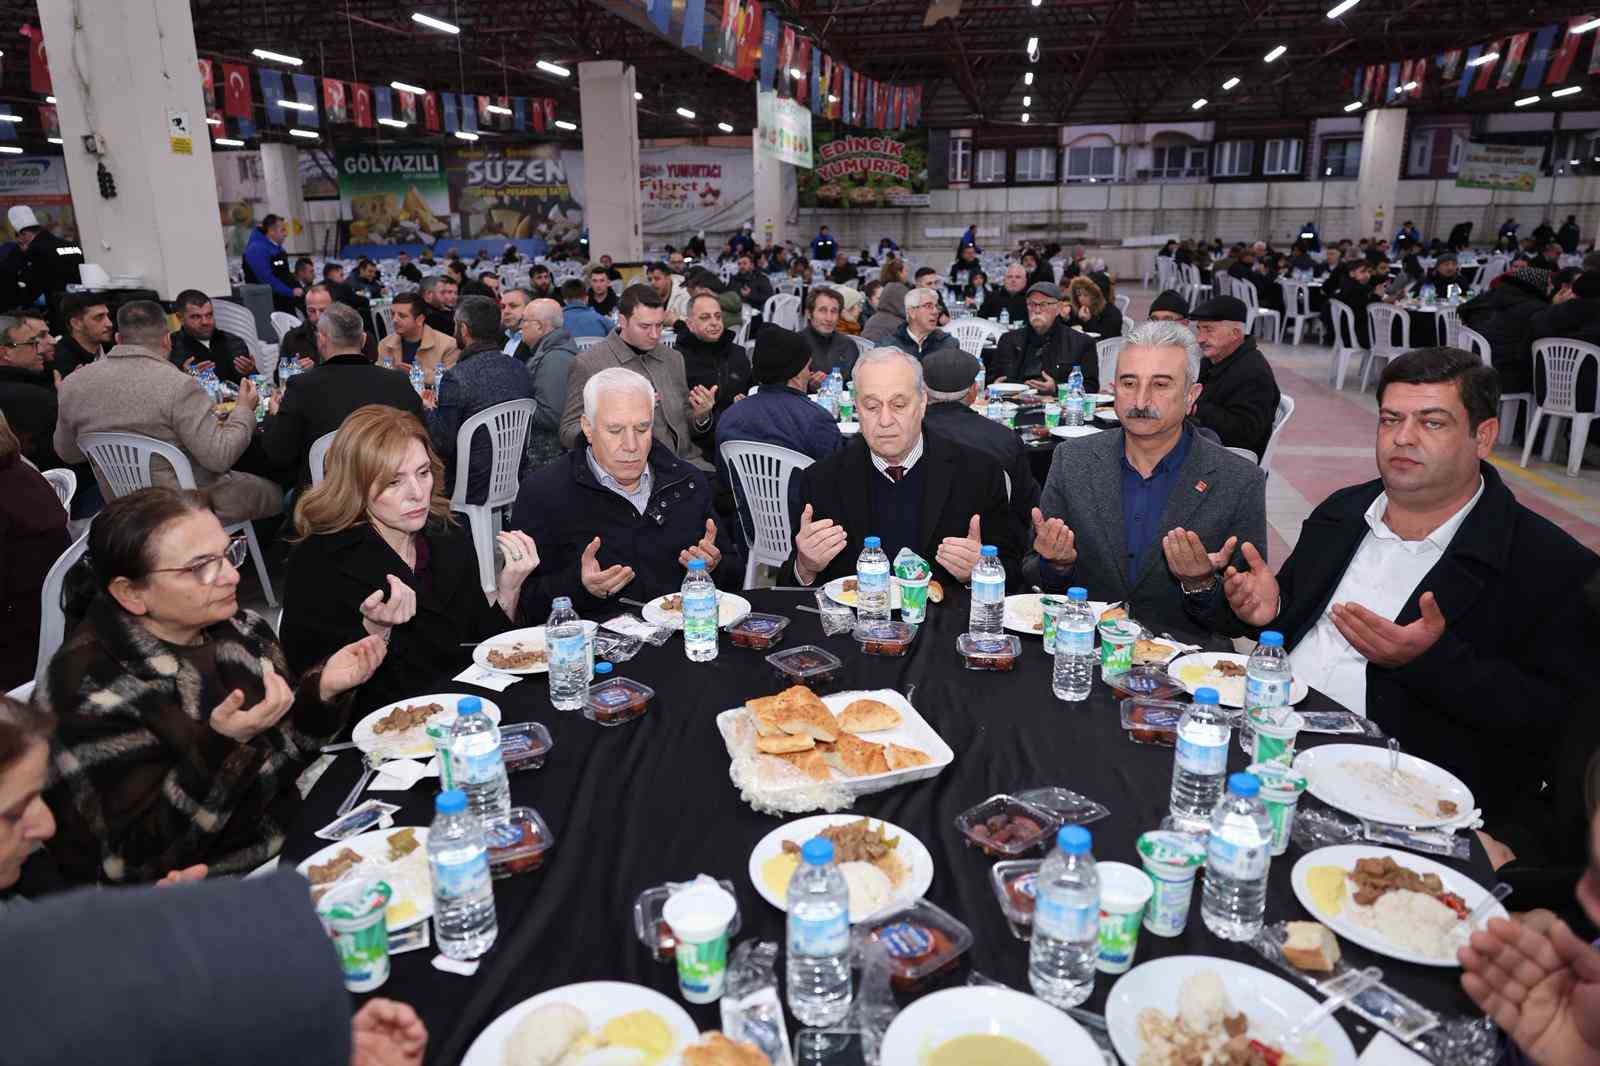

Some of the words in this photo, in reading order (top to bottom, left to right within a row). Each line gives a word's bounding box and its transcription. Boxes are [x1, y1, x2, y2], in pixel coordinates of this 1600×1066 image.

[821, 136, 905, 159] EDİNCİK
[344, 154, 440, 174] GÖLYAZILI
[466, 153, 567, 185] SÜZEN
[818, 156, 910, 181] YUMURTA
